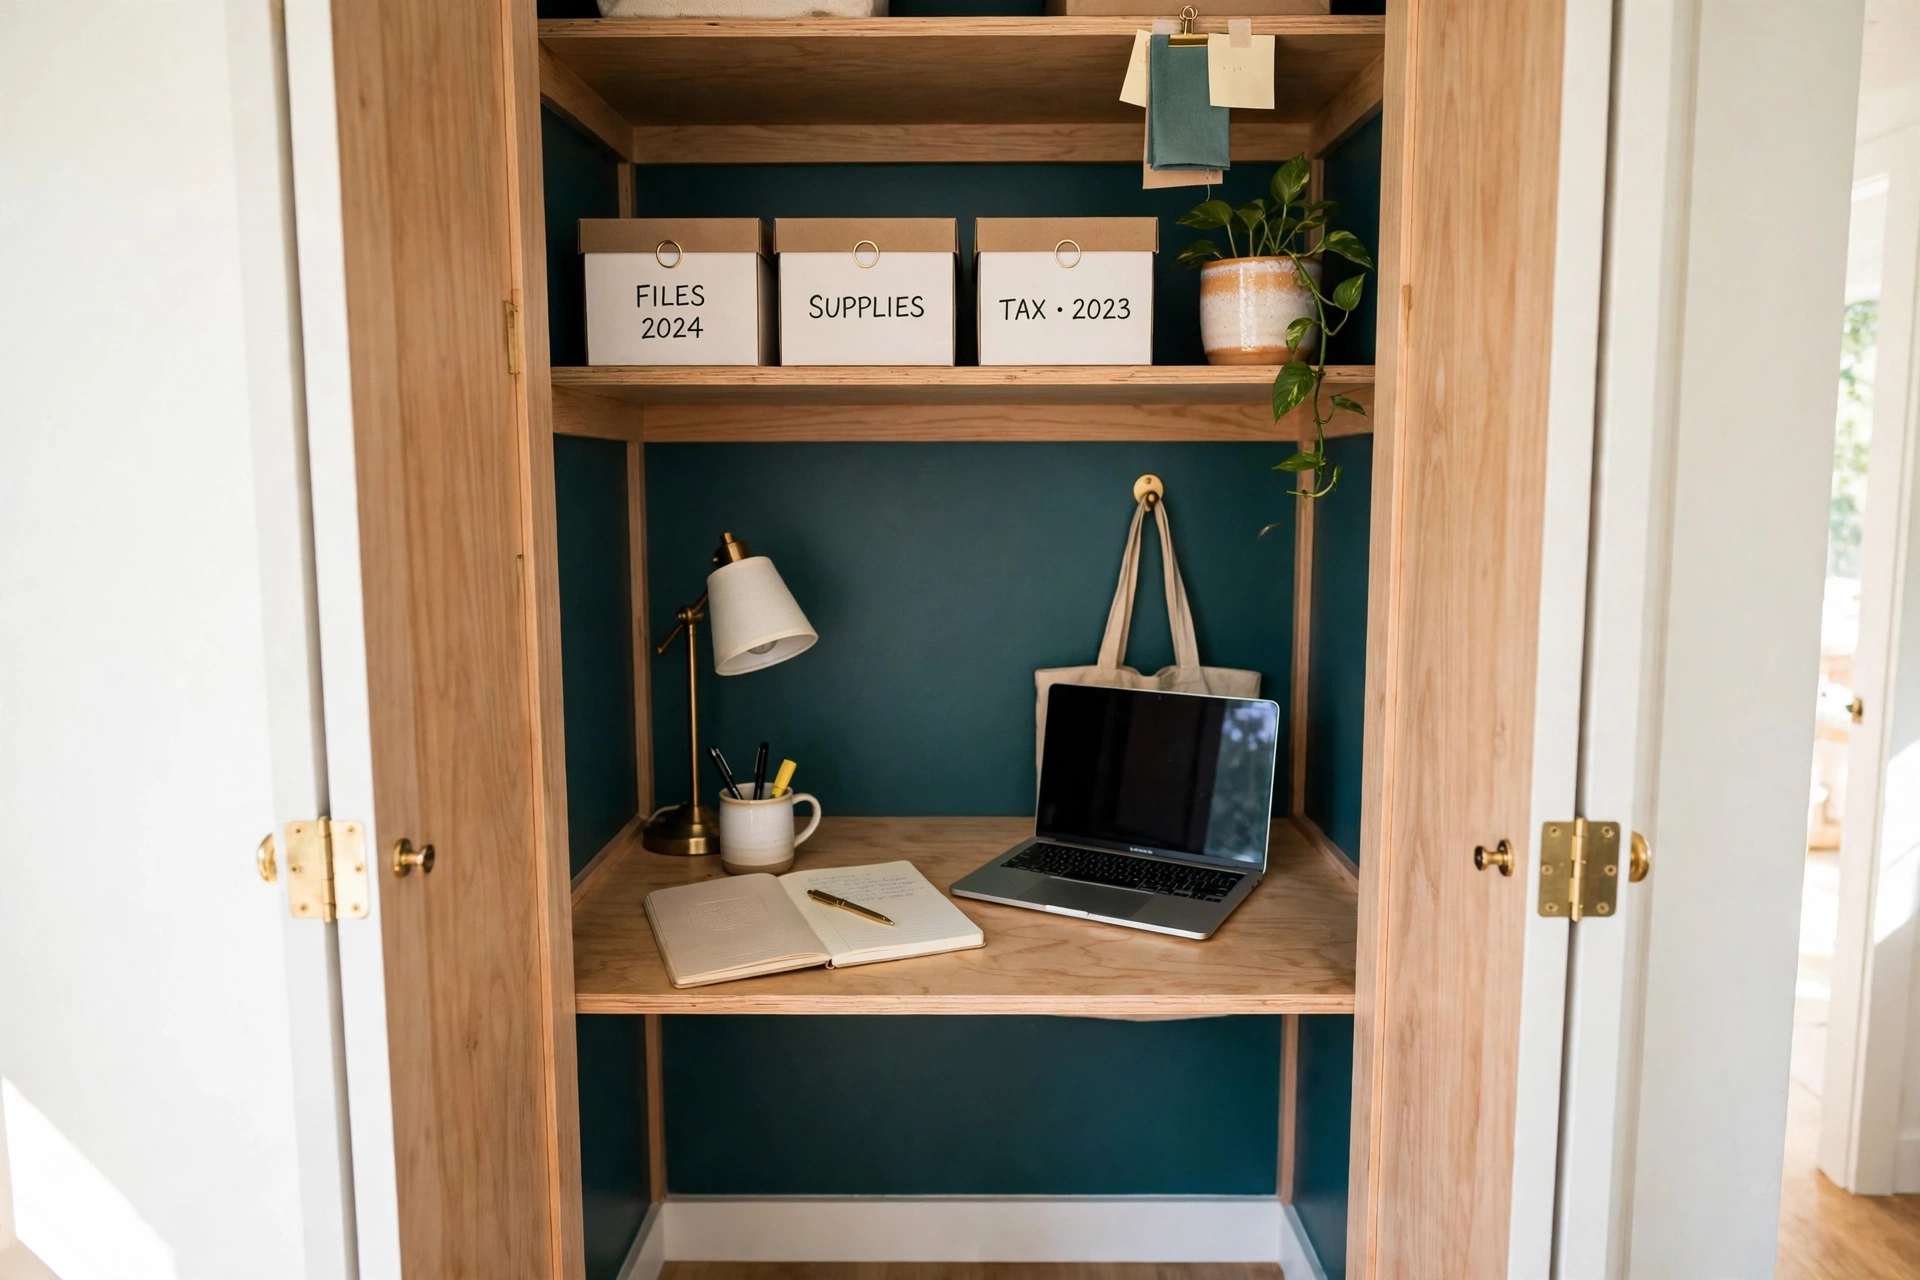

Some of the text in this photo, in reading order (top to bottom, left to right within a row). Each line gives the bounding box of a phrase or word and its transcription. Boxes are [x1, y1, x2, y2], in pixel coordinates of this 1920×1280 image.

[636, 284, 705, 308] FILES
[808, 294, 925, 319] SUPPLIES
[998, 298, 1046, 320] TAX
[1072, 297, 1131, 320] 2023
[641, 316, 704, 340] 2024
